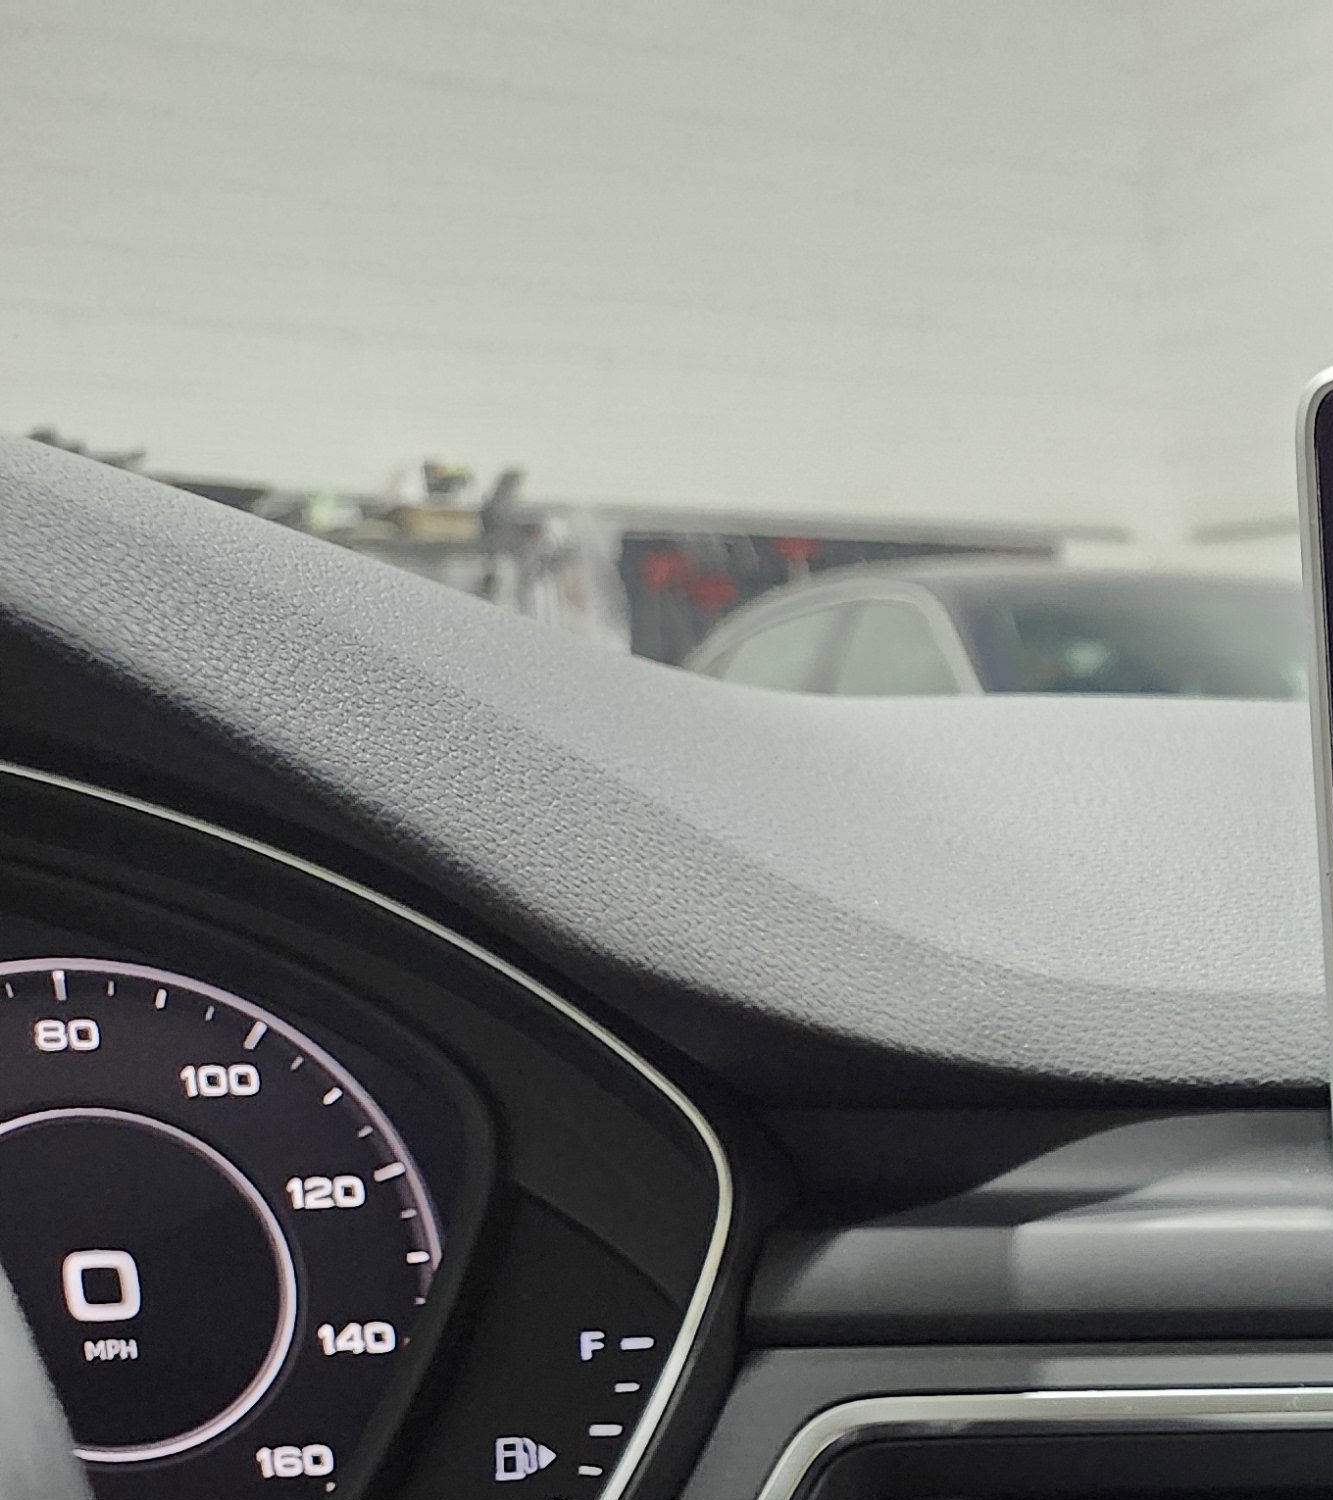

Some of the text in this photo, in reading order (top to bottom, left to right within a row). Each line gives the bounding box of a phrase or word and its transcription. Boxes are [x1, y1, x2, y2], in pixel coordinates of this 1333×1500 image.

[35, 1019, 100, 1051] 80
[179, 1063, 261, 1098] 100
[285, 1173, 365, 1211] 120
[63, 1249, 141, 1321] 0
[83, 1338, 138, 1362] MPH
[316, 1320, 396, 1356] 140
[578, 1330, 606, 1361] F
[256, 1444, 334, 1478] 160
